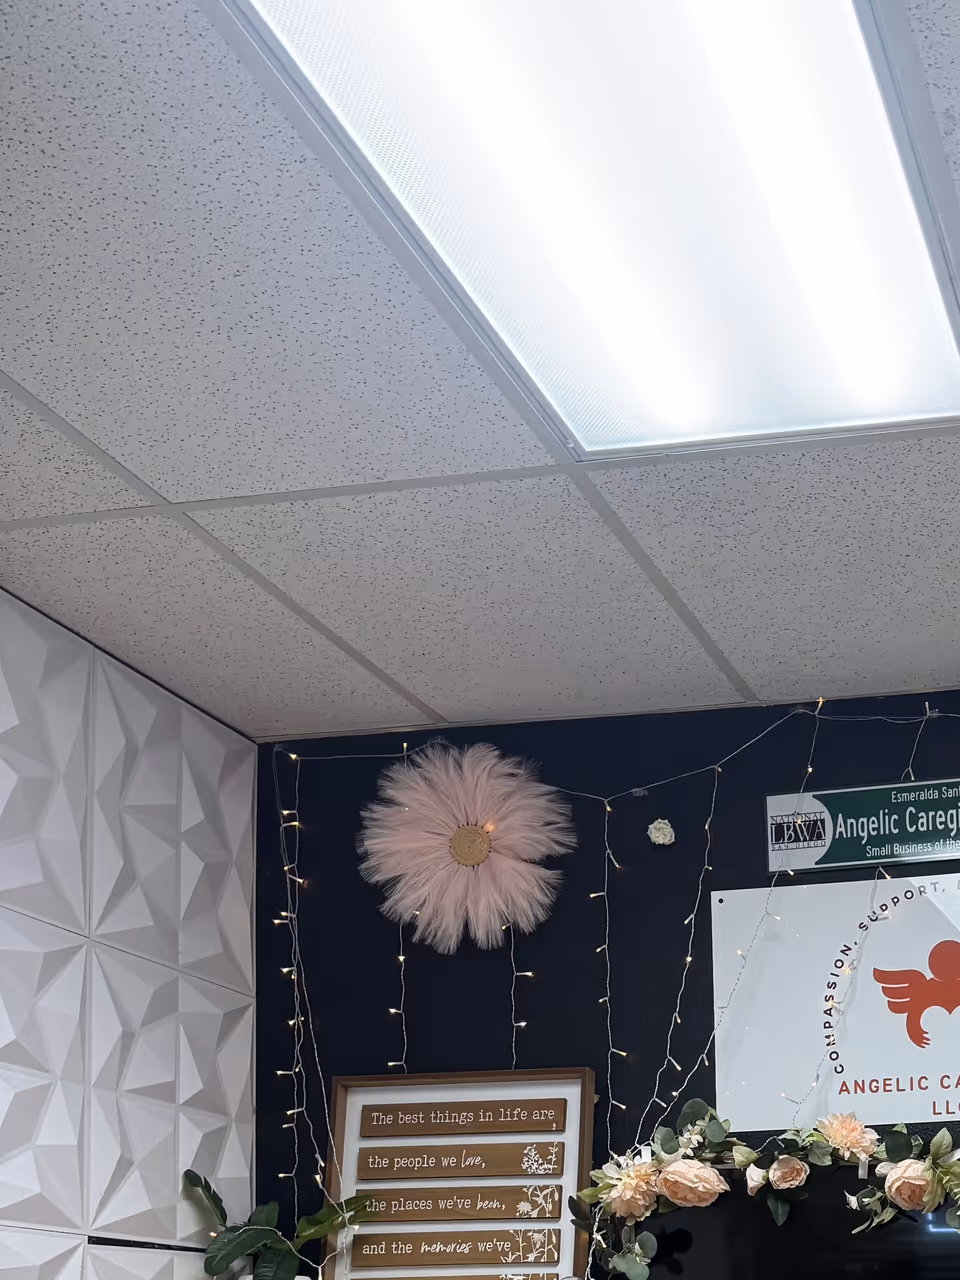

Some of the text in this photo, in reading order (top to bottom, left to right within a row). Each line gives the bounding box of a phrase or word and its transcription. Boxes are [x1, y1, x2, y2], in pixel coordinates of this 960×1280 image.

[891, 788, 939, 803] Esmeralda
[771, 820, 826, 844] LBWA
[835, 808, 899, 845] Angelic
[866, 843, 891, 857] Small
[893, 841, 931, 855] Business
[934, 838, 944, 851] of
[946, 838, 960, 849] the
[823, 940, 858, 1074] COMPASSION,
[858, 881, 946, 931] SUPPORT,
[838, 1075, 929, 1096] ANGELIC
[371, 1107, 555, 1125] The best things in life are
[367, 1149, 486, 1171] the people we love,
[365, 1193, 506, 1214] the places we've been,
[362, 1238, 511, 1255] and the memories we've
